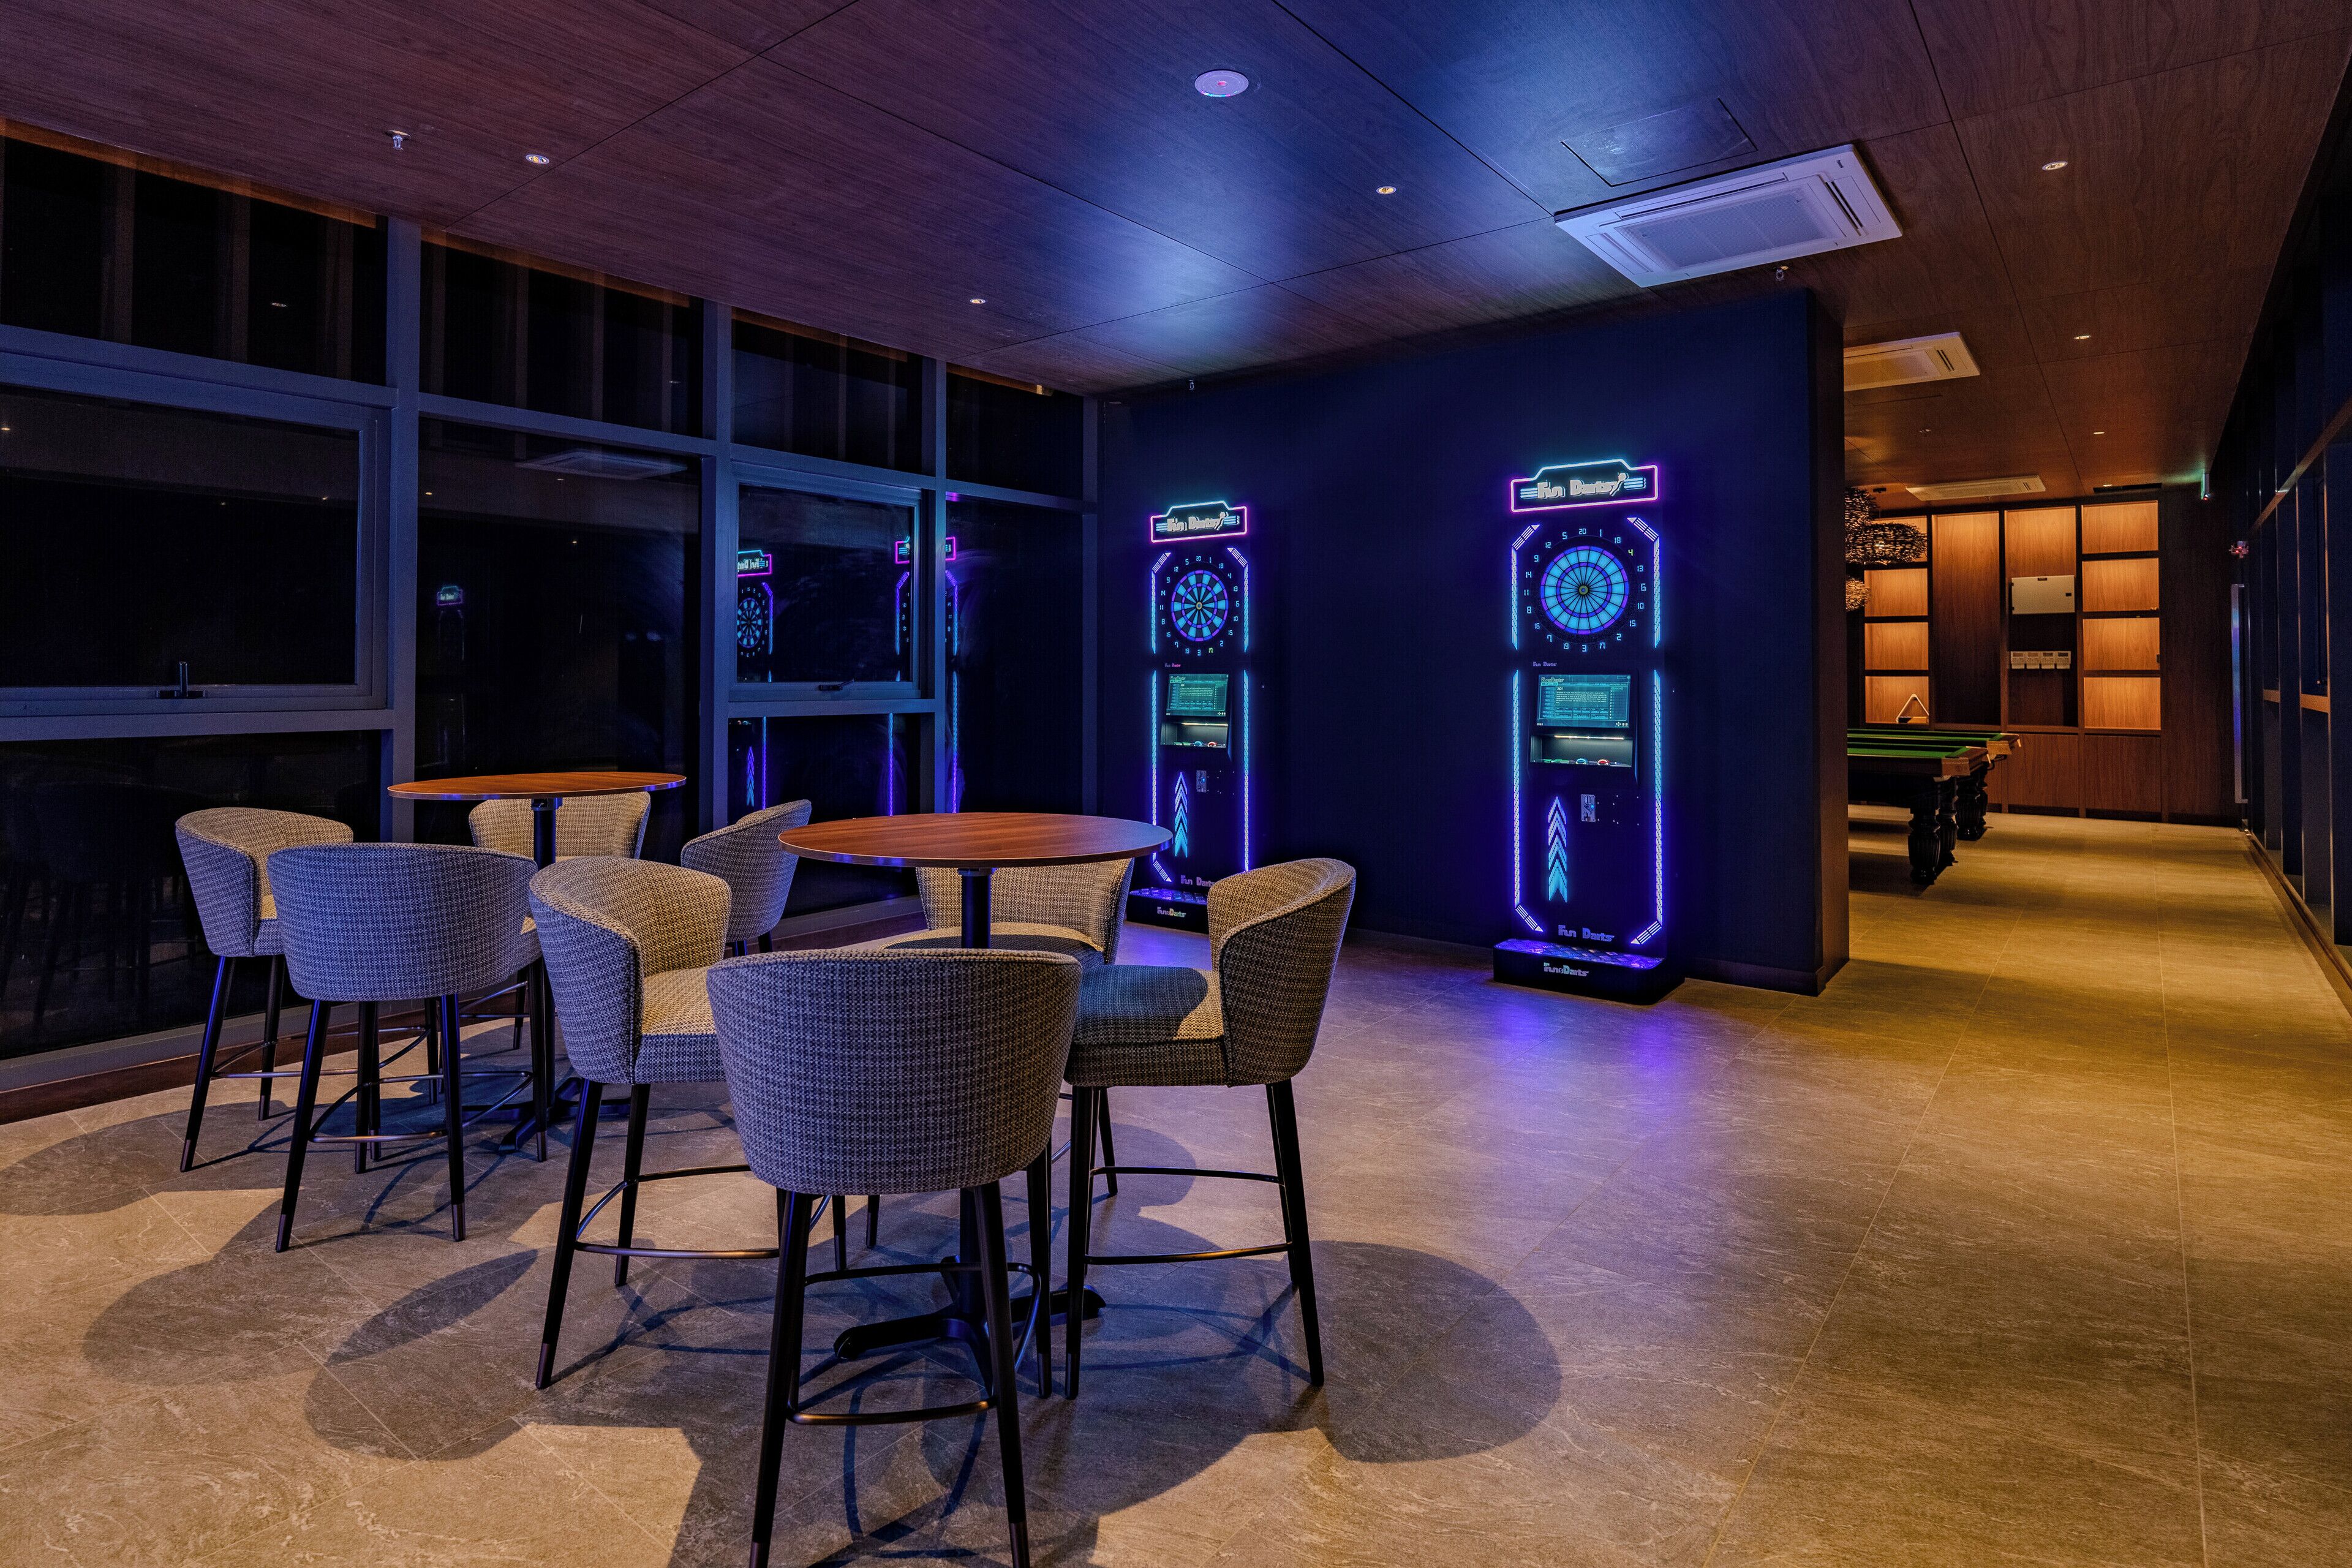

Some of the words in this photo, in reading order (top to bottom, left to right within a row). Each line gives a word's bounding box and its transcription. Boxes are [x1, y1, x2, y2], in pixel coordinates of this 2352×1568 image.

[1537, 481, 1564, 499] Fun
[1181, 875, 1193, 885] Fun
[1558, 924, 1577, 938] Fun
[1582, 927, 1615, 942] Darts
